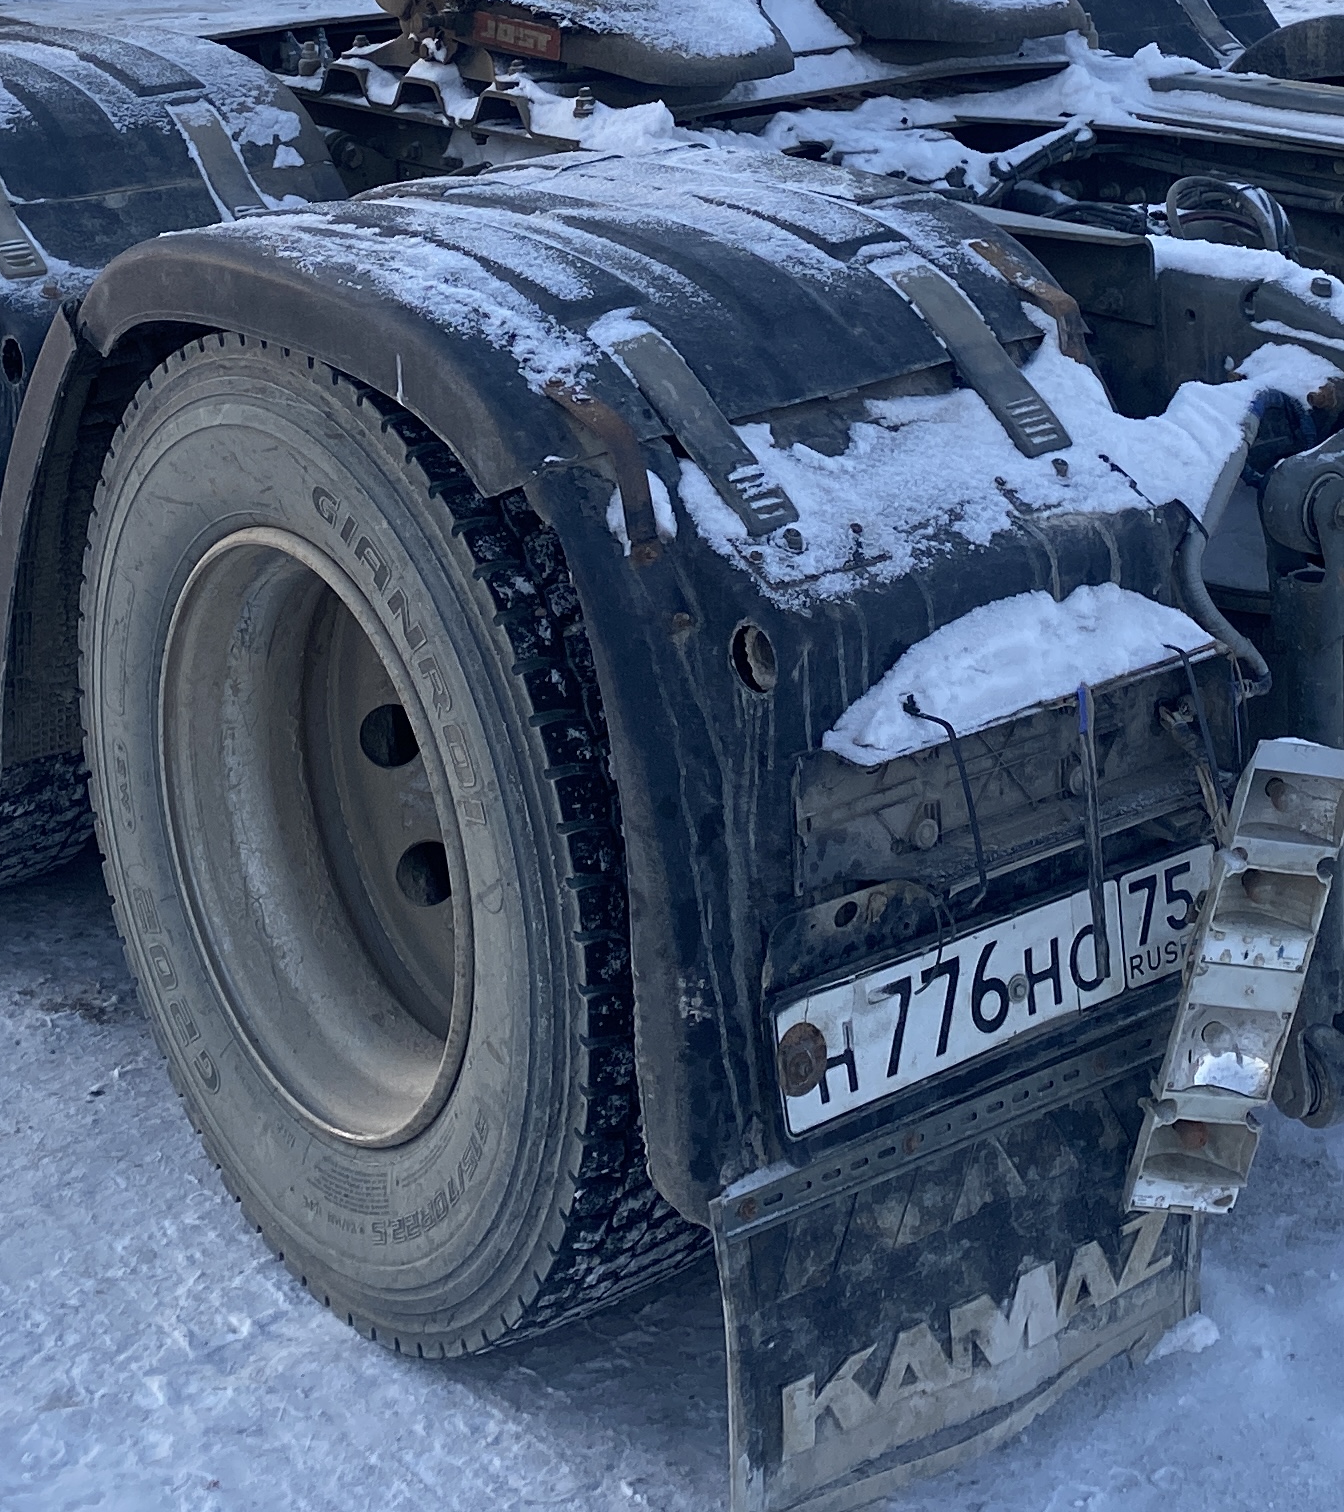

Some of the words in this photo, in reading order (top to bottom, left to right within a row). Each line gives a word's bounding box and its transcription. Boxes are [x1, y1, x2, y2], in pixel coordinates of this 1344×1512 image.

[1128, 860, 1194, 947] 75
[1129, 940, 1179, 980] RUS
[782, 1210, 1173, 1463] KAMAZ
